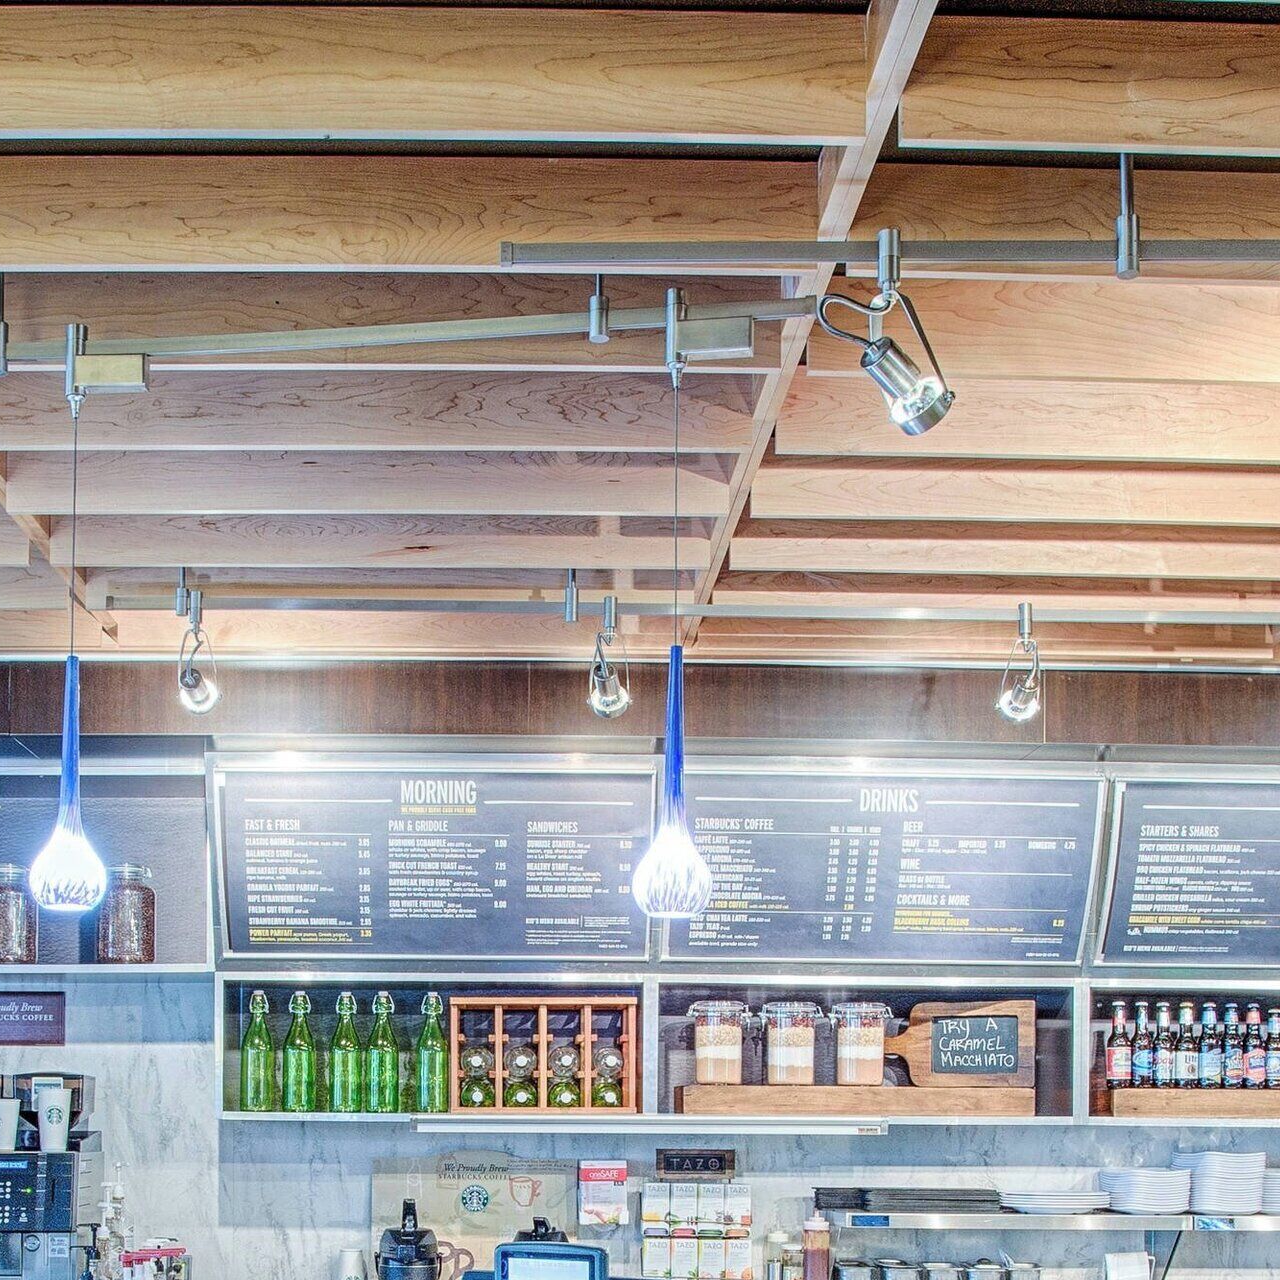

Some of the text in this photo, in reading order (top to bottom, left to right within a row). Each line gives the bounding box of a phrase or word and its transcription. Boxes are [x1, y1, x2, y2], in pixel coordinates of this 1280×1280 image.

[400, 780, 477, 804] MORNING
[860, 789, 919, 812] DRINKS
[245, 819, 300, 831] FAST & FRESH
[388, 820, 448, 832] PAN & GRIDDLE
[527, 821, 578, 833] SANDWICHES
[745, 819, 774, 830] COFFEE
[903, 821, 923, 833] BEER
[1140, 825, 1219, 838] STARTERS & SHARES
[1156, 844, 1178, 852] CHICKEN
[900, 858, 920, 870] WINE
[1149, 866, 1172, 874] CHICKEN
[897, 894, 970, 906] COCKTAILS & MORE
[21, 1002, 43, 1012] Brew
[938, 1017, 998, 1041] TRY A
[939, 1035, 1005, 1051] CARAMEL
[940, 1051, 1014, 1067] MACCHIATO
[444, 1163, 457, 1172] We
[459, 1163, 487, 1174] Proudly
[489, 1163, 509, 1172] Brew
[670, 1158, 720, 1170] TAZO
[648, 1185, 667, 1193] TAZO
[675, 1185, 695, 1193] TAZO
[702, 1186, 721, 1194] TAZO
[728, 1186, 748, 1194] TAZO
[648, 1241, 667, 1249] TAZO
[703, 1242, 722, 1250] TAZO
[730, 1242, 749, 1250] TAZO
